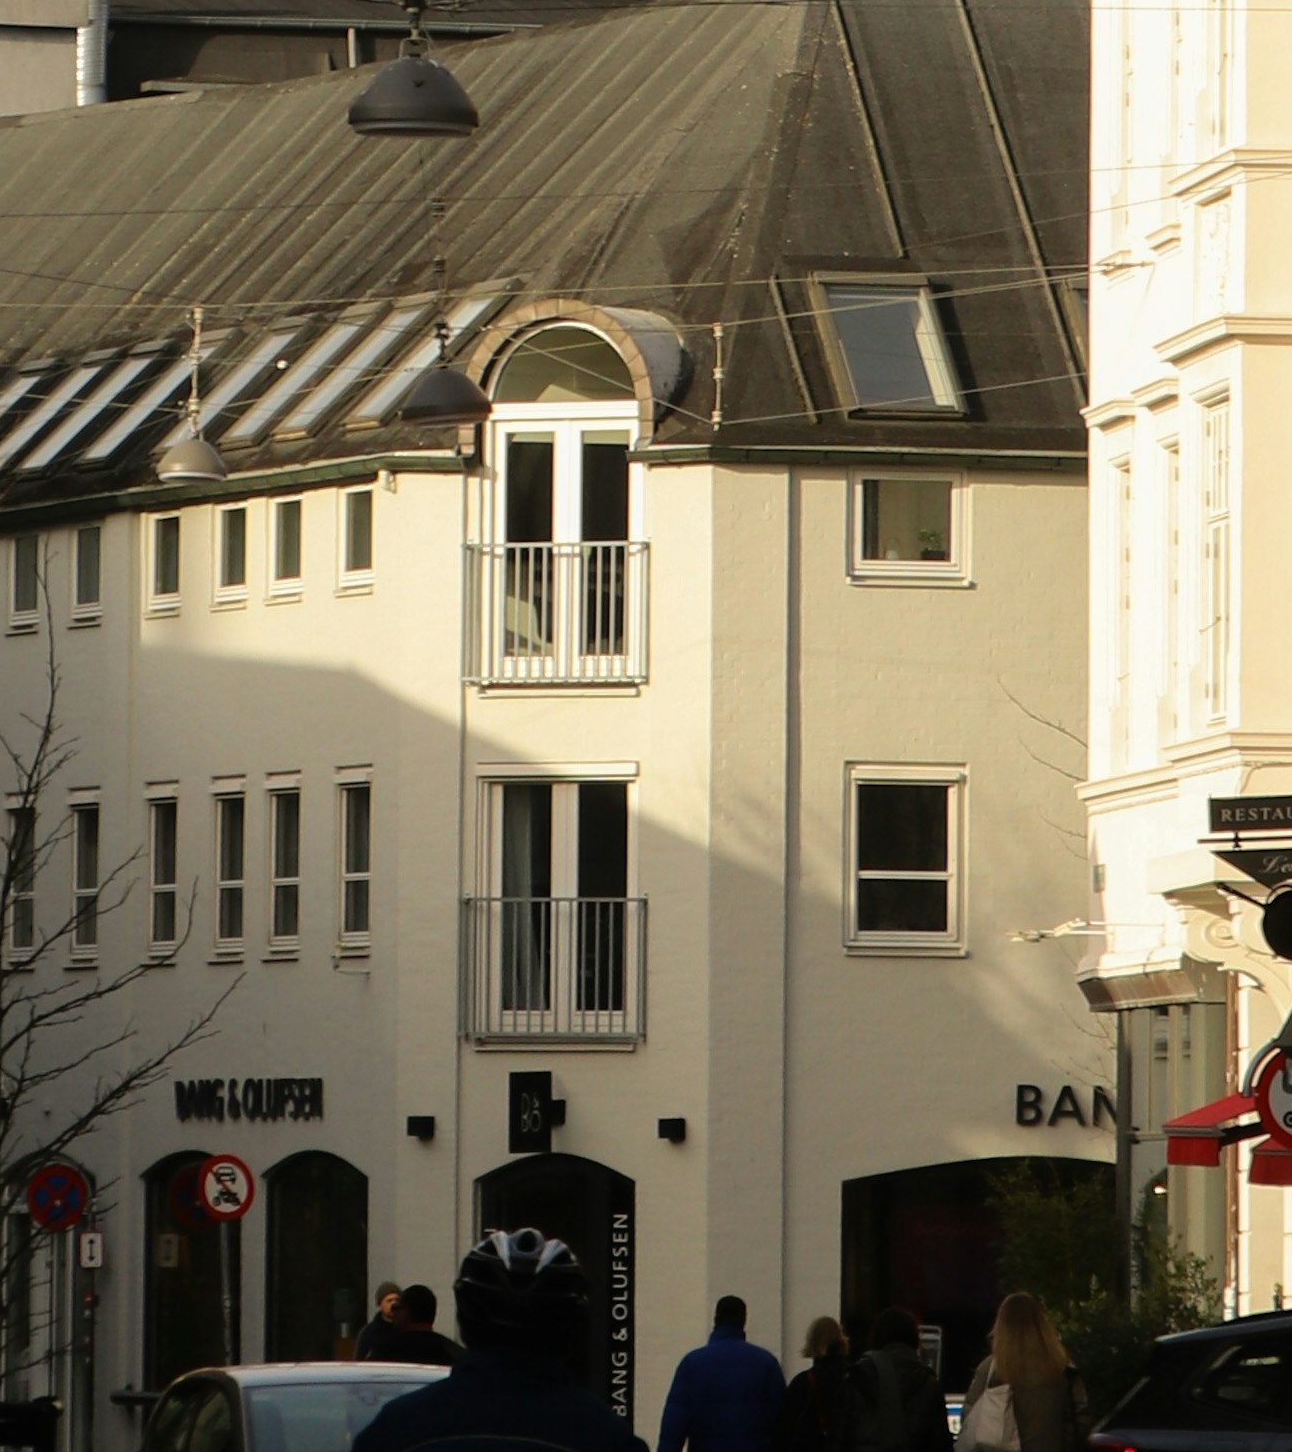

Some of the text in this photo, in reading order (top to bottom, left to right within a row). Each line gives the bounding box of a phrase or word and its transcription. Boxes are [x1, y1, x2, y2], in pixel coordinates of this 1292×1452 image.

[242, 1078, 323, 1122] OLUFSEN
[1016, 1084, 1118, 1127] BAN
[611, 1212, 629, 1417] BANG & OLUFSEN
